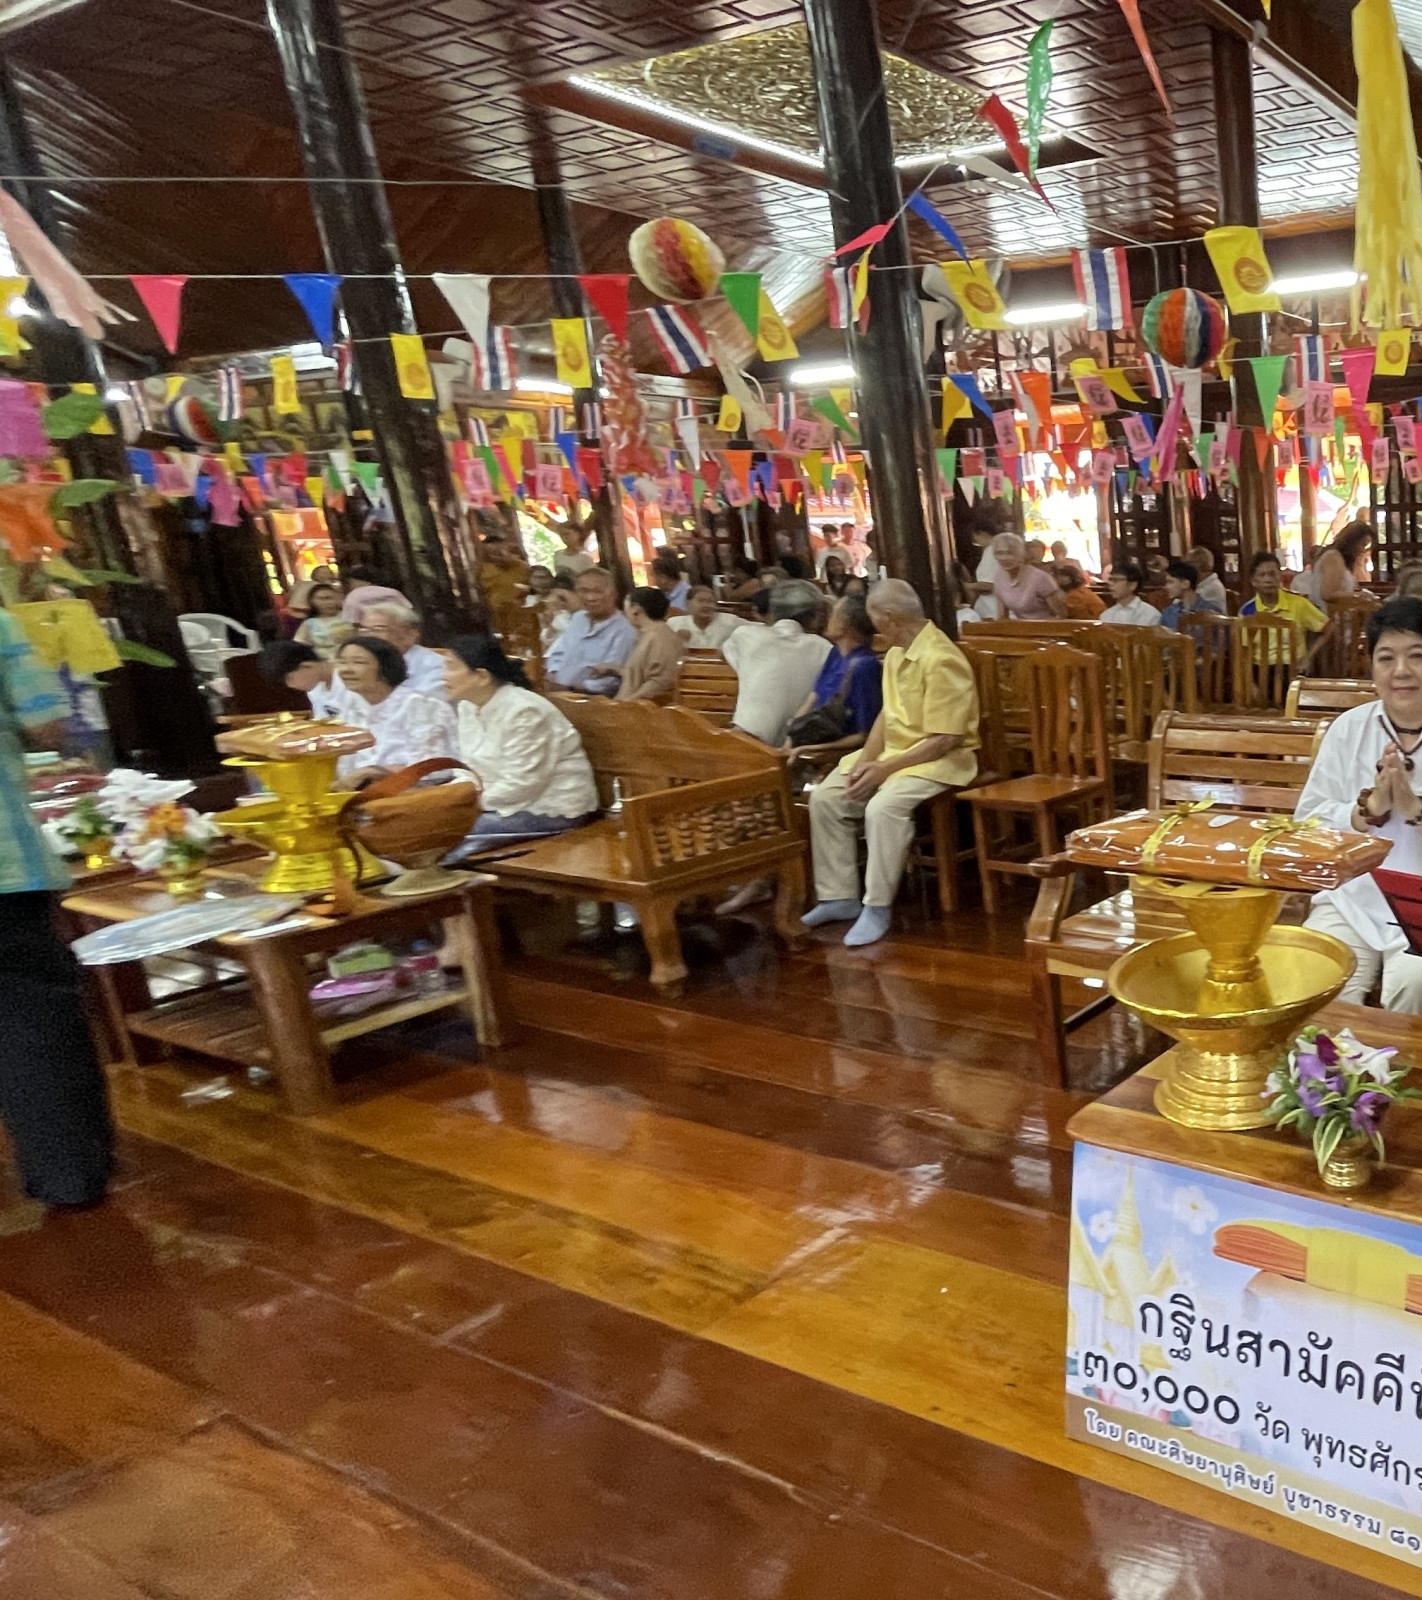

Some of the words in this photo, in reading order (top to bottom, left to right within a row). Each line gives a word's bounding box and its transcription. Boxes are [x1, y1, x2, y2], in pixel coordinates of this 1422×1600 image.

[1084, 1351, 1240, 1425] ๓๐,๐๐๐
[1254, 1401, 1290, 1444] วัด
[1084, 1408, 1121, 1441] โดย
[1126, 1430, 1275, 1496] คณะศิษยานุศิษย์
[1281, 1487, 1382, 1536] บูชาธรรม
